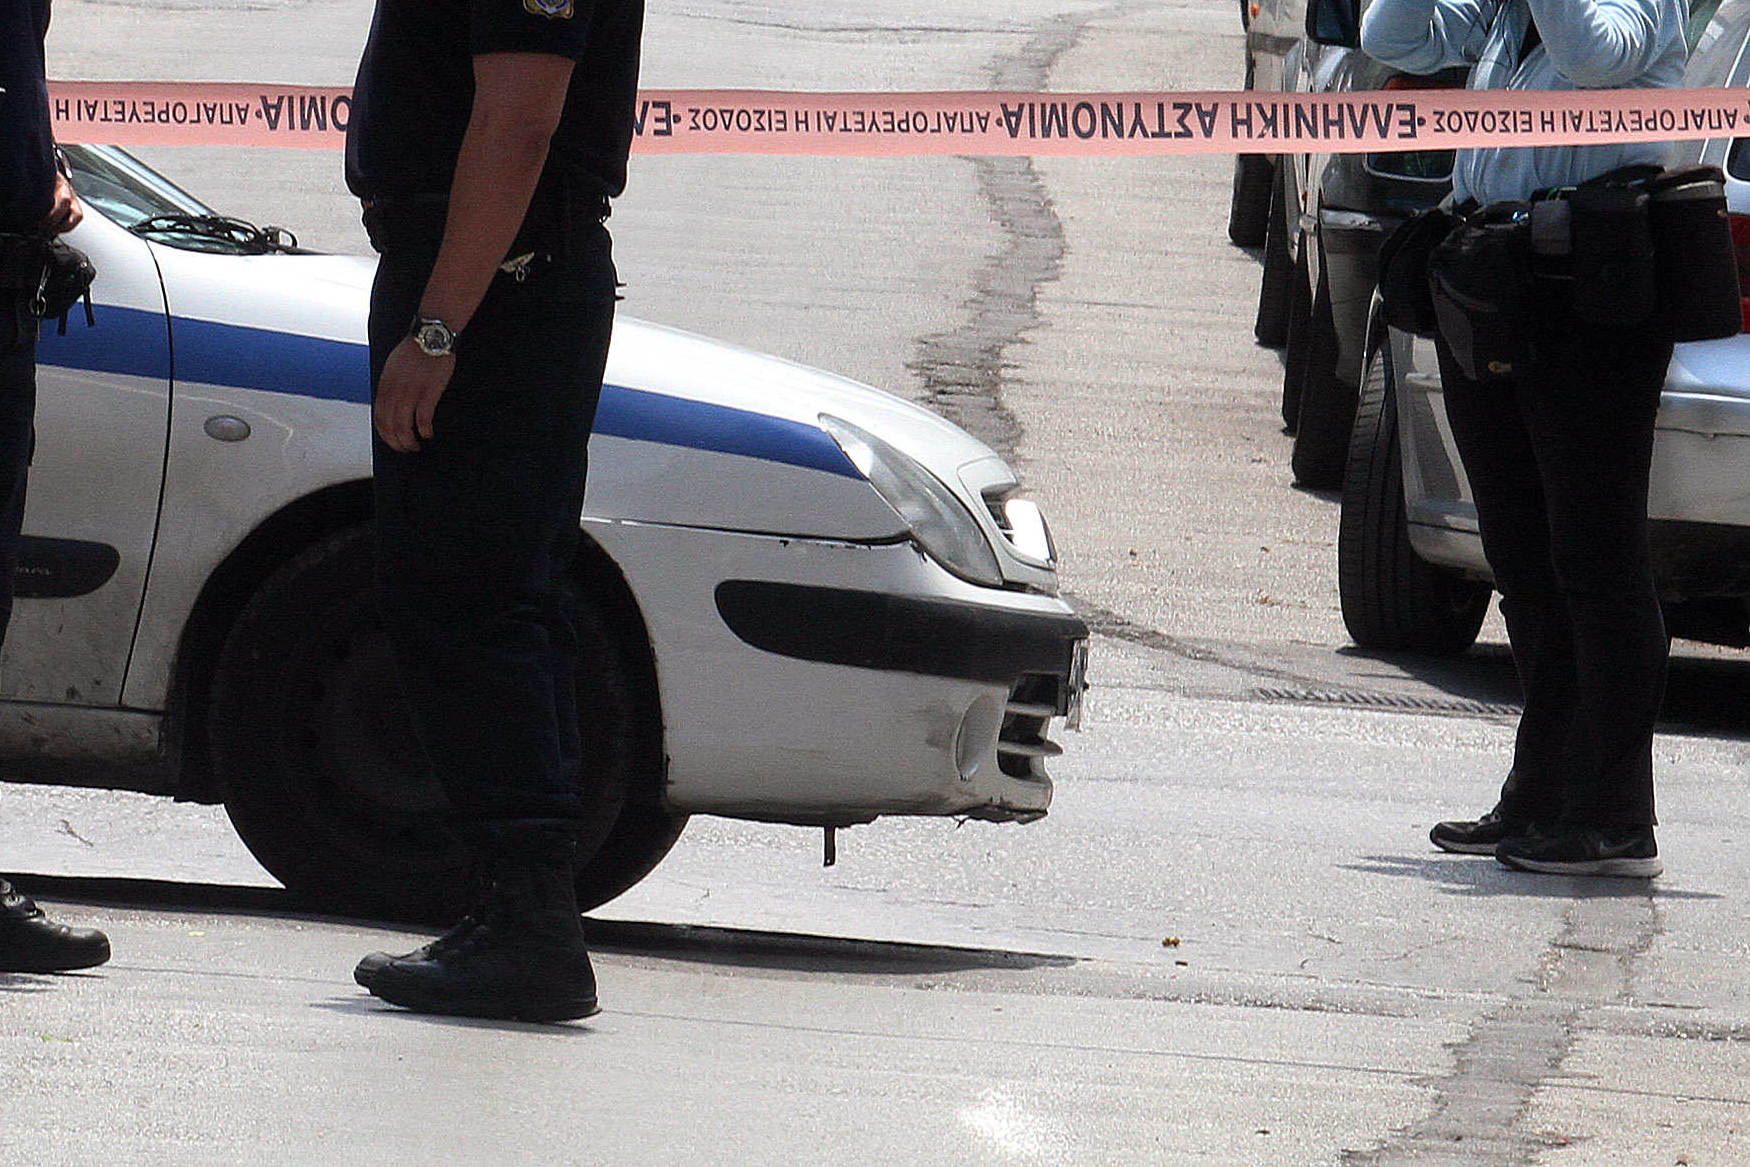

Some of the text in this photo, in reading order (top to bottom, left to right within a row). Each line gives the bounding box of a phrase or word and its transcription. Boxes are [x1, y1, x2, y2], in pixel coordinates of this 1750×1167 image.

[56, 99, 70, 121] Η
[77, 99, 250, 124] ΑΠΑΓΟΡΕΥΕΤΑΙ
[688, 109, 788, 131] ΕΙΣΟΔΟΣ
[1000, 102, 1220, 139] ΑΣΤΥΝΟΜΙΑ
[1231, 102, 1417, 138] ΕΛΛΗΝΙΚΗ
[1562, 109, 1738, 133] ΑΠΑΓΟΡΕΥΕΤΑΙ
[795, 111, 810, 132] Η
[817, 111, 991, 133] ΑΠΑΓΟΡΕΥΕΤΑΙ
[1433, 110, 1533, 133] ΕΙΣΟΔΟΣ
[1541, 111, 1555, 133] Η
